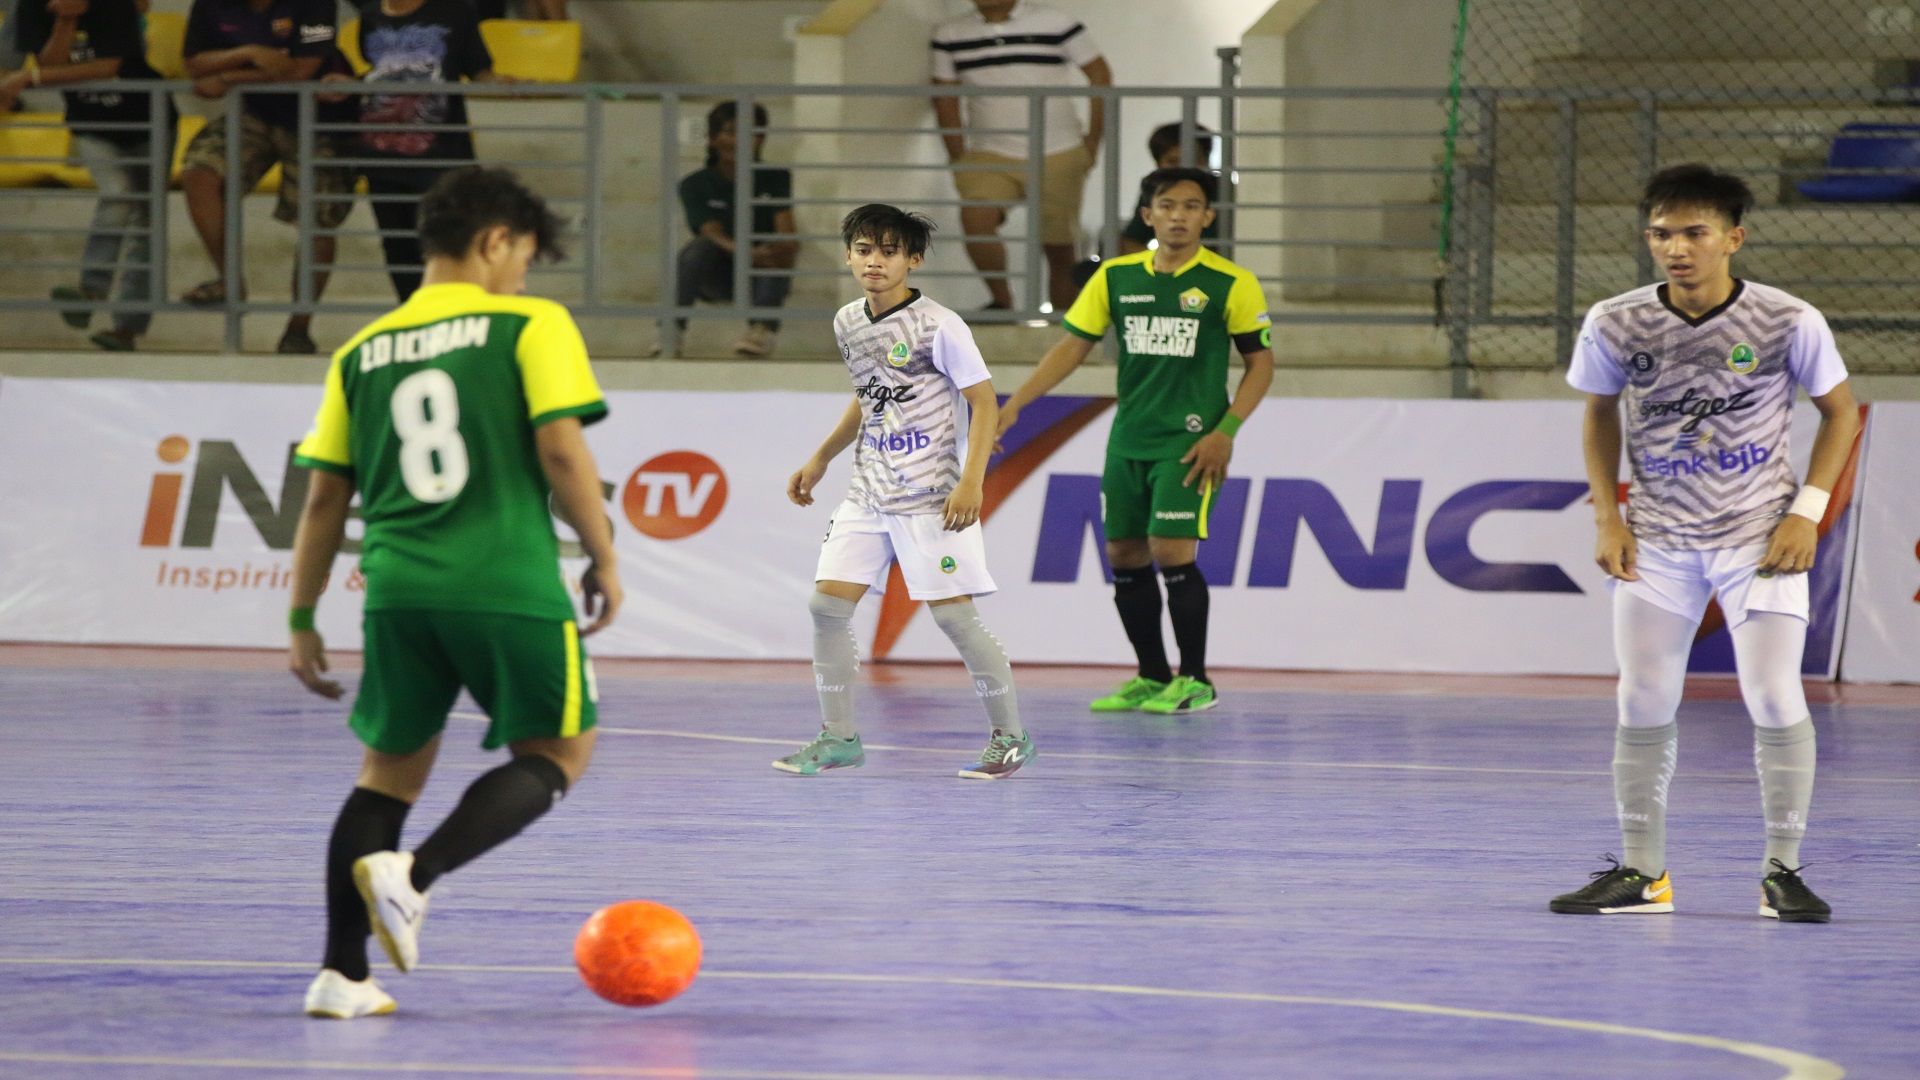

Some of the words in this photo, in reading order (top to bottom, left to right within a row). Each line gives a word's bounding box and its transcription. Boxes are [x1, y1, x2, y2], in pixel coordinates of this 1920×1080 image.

[1123, 315, 1200, 339] SULAWESI
[1123, 334, 1197, 358] TENGGARA
[390, 368, 470, 504] 8
[889, 431, 931, 455] bjb
[1644, 449, 1714, 477] bank
[1718, 443, 1769, 474] bjb
[636, 471, 720, 519] TV
